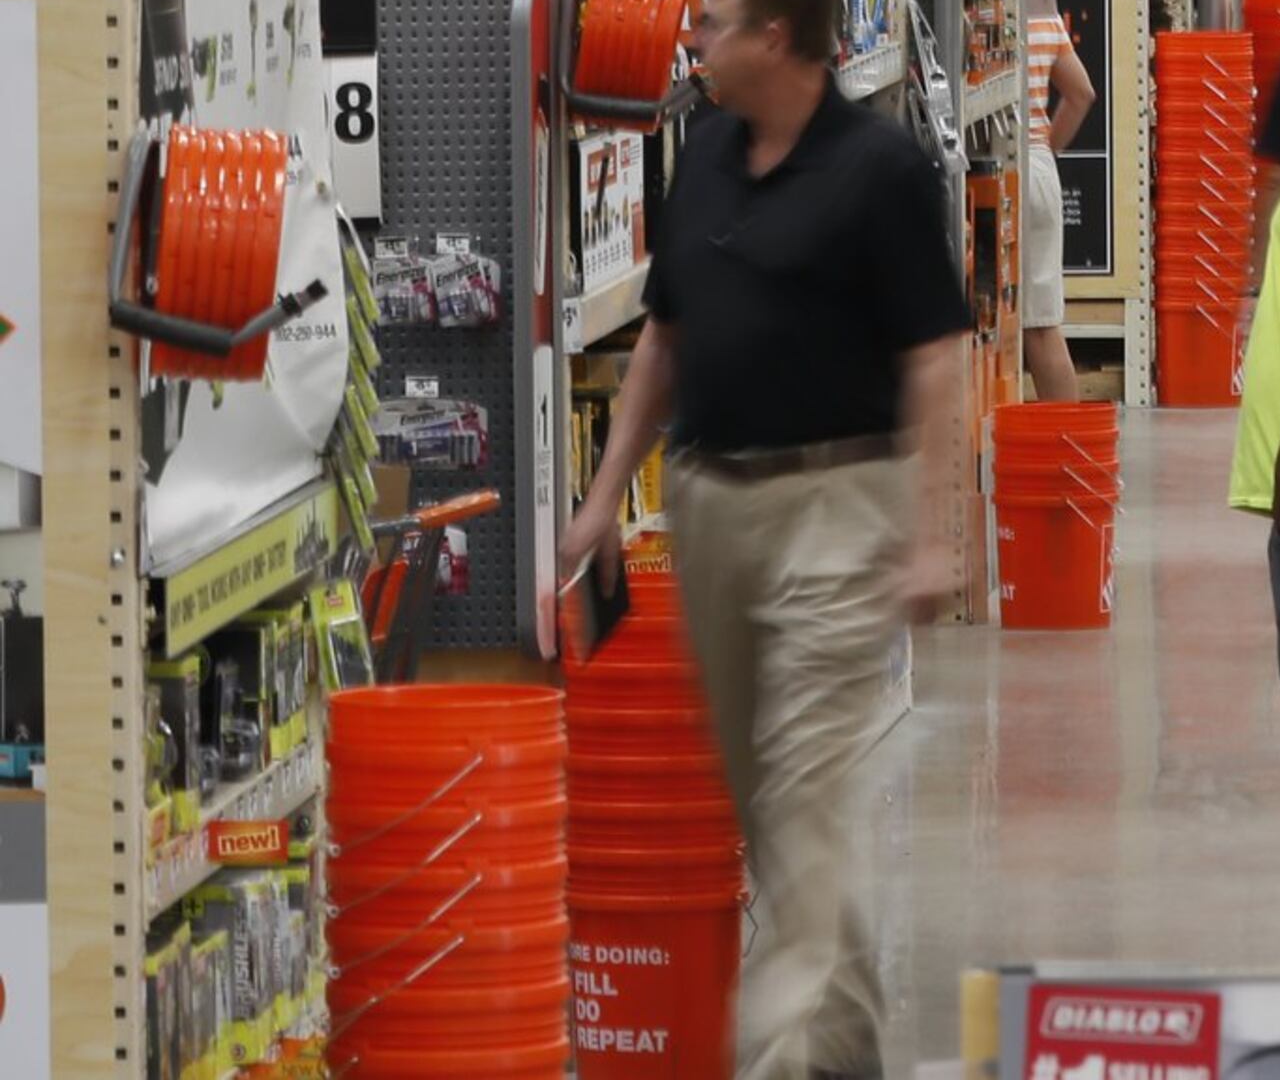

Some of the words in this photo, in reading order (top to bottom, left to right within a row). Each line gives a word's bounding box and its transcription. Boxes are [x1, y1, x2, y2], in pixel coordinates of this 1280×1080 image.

[334, 81, 375, 143] 8
[219, 825, 281, 854] new!
[595, 946, 671, 966] DOING:
[574, 970, 619, 997] FILL
[1053, 1004, 1161, 1034] DIABLO
[576, 1026, 669, 1053] REPEAT
